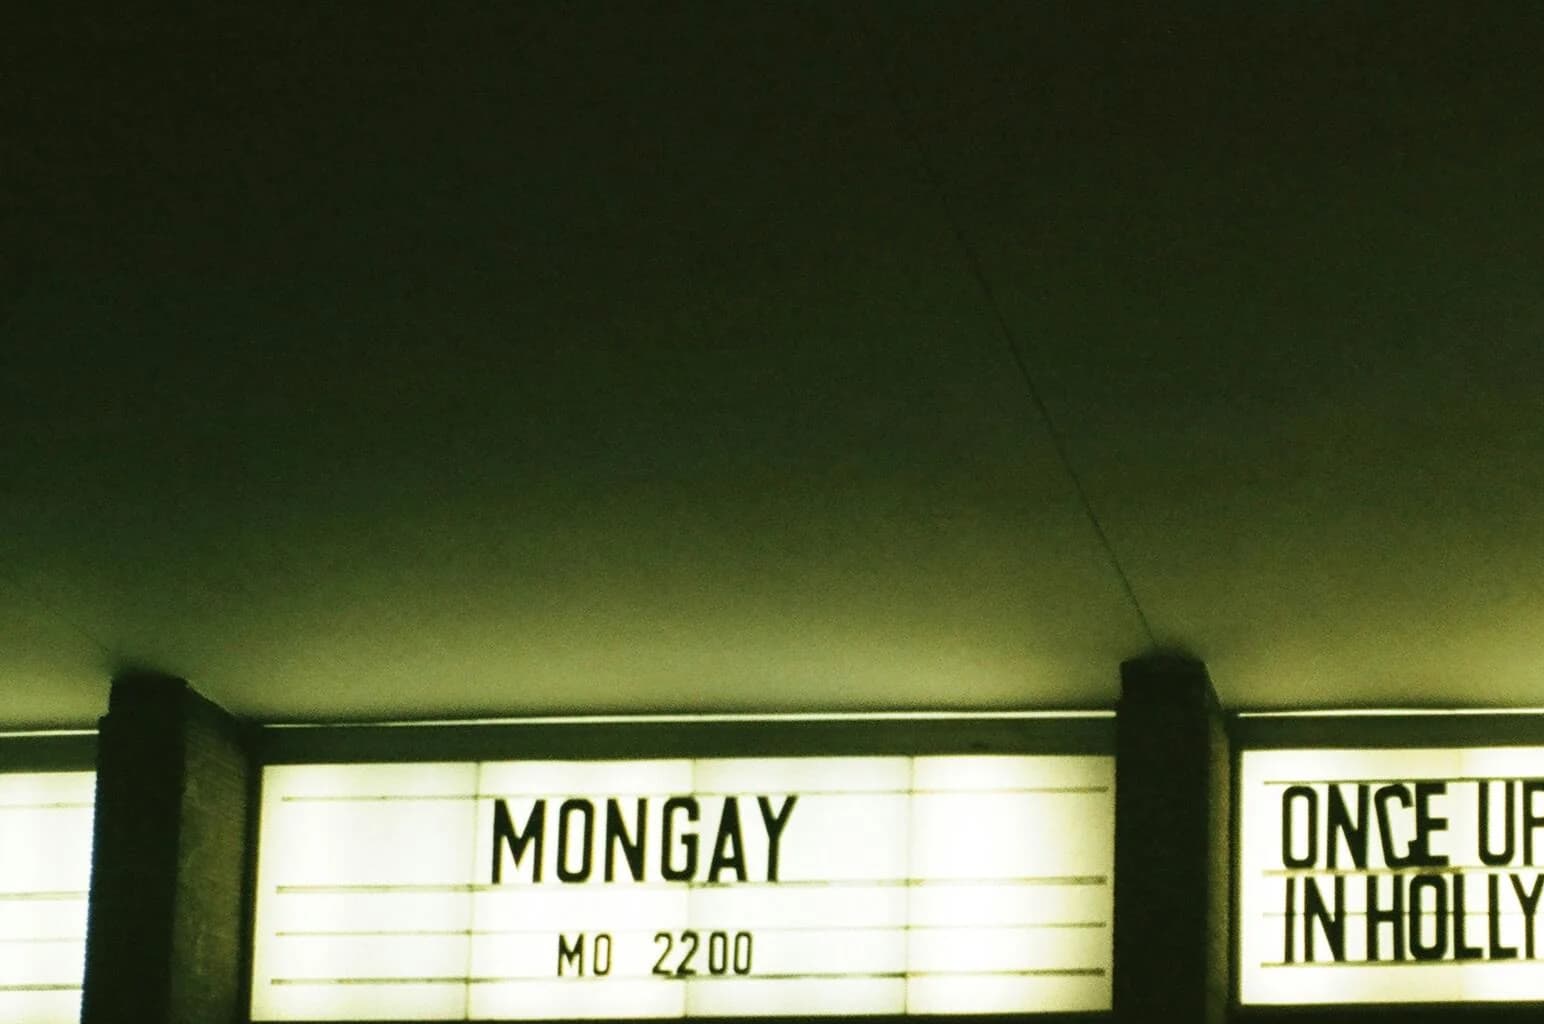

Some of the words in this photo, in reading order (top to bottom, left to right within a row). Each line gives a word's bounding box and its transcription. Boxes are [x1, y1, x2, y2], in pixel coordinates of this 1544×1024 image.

[493, 797, 796, 884] MONGAY
[1283, 783, 1448, 867] ONCE
[558, 934, 611, 976] MO
[652, 932, 751, 976] 2200
[1285, 876, 1345, 963] IN
